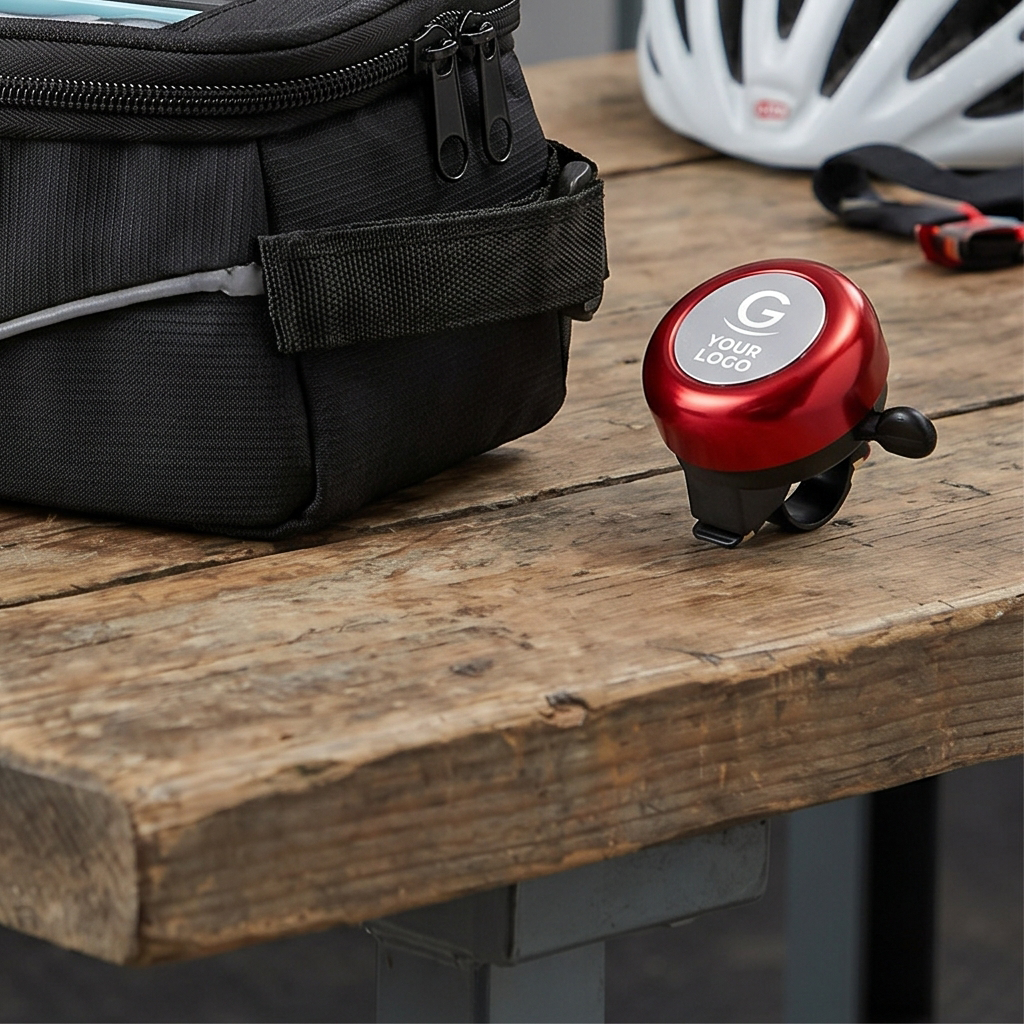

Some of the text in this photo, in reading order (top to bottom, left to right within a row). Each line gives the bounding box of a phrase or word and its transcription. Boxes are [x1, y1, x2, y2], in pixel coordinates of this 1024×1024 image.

[737, 290, 791, 329] G
[708, 333, 762, 359] YOUR
[693, 348, 752, 372] LOGO
